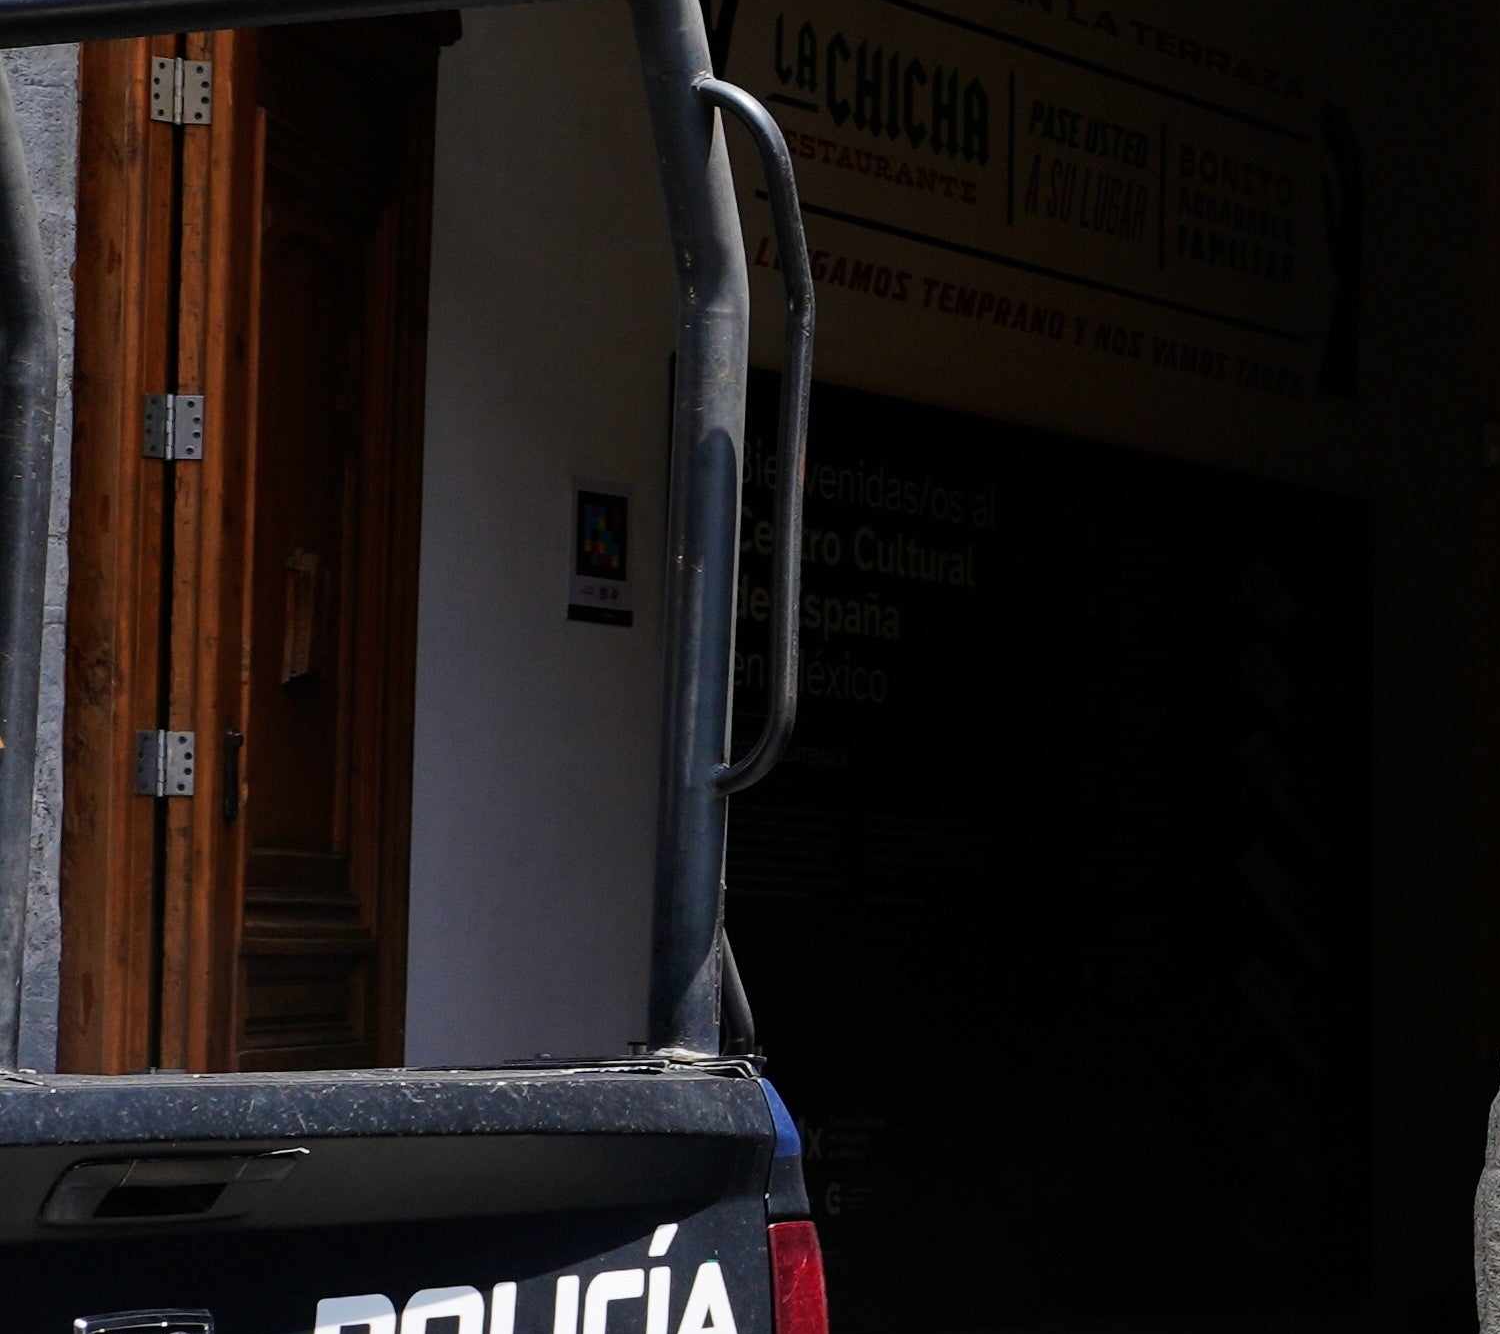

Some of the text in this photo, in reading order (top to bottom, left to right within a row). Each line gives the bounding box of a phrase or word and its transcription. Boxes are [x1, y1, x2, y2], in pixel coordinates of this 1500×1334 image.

[774, 12, 989, 166] LA CHICHA
[1130, 18, 1307, 101] TERRAZA
[783, 127, 978, 205] ESTAURANTE
[1027, 98, 1149, 170] PASE USTED
[1023, 153, 1148, 243] A SU LUGAR
[1179, 143, 1297, 208] BONITO
[1177, 223, 1295, 284] FAMILIAR
[754, 235, 1302, 399] LGAMOS TEMPRANO Y NOS VAMOS TARDE
[853, 525, 978, 589] Cultural
[802, 589, 901, 643] spaña
